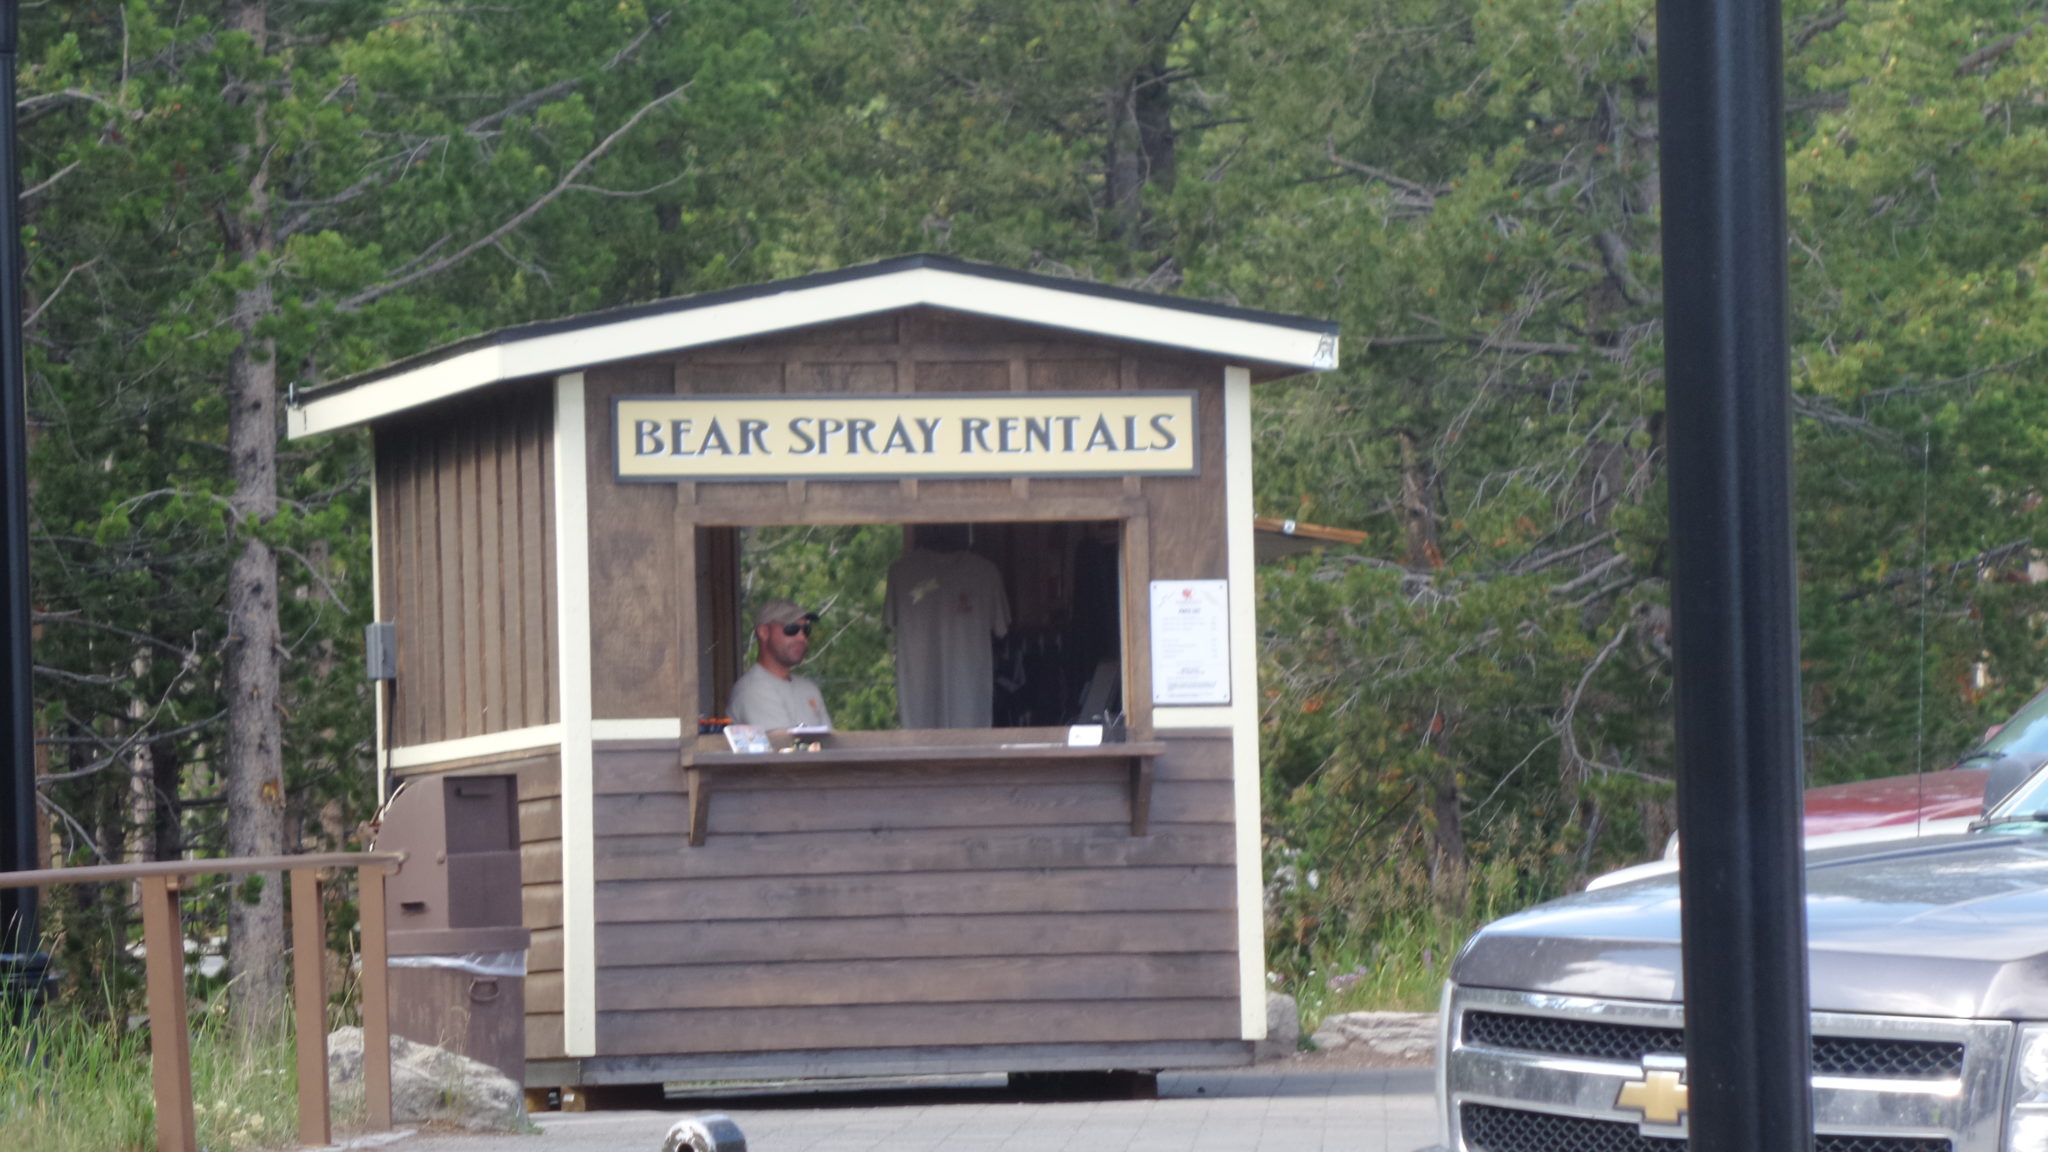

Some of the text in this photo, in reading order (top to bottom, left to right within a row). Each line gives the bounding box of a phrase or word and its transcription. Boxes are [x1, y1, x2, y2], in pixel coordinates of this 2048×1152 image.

[634, 413, 1178, 456] BEAR SPRAY RENTALS
